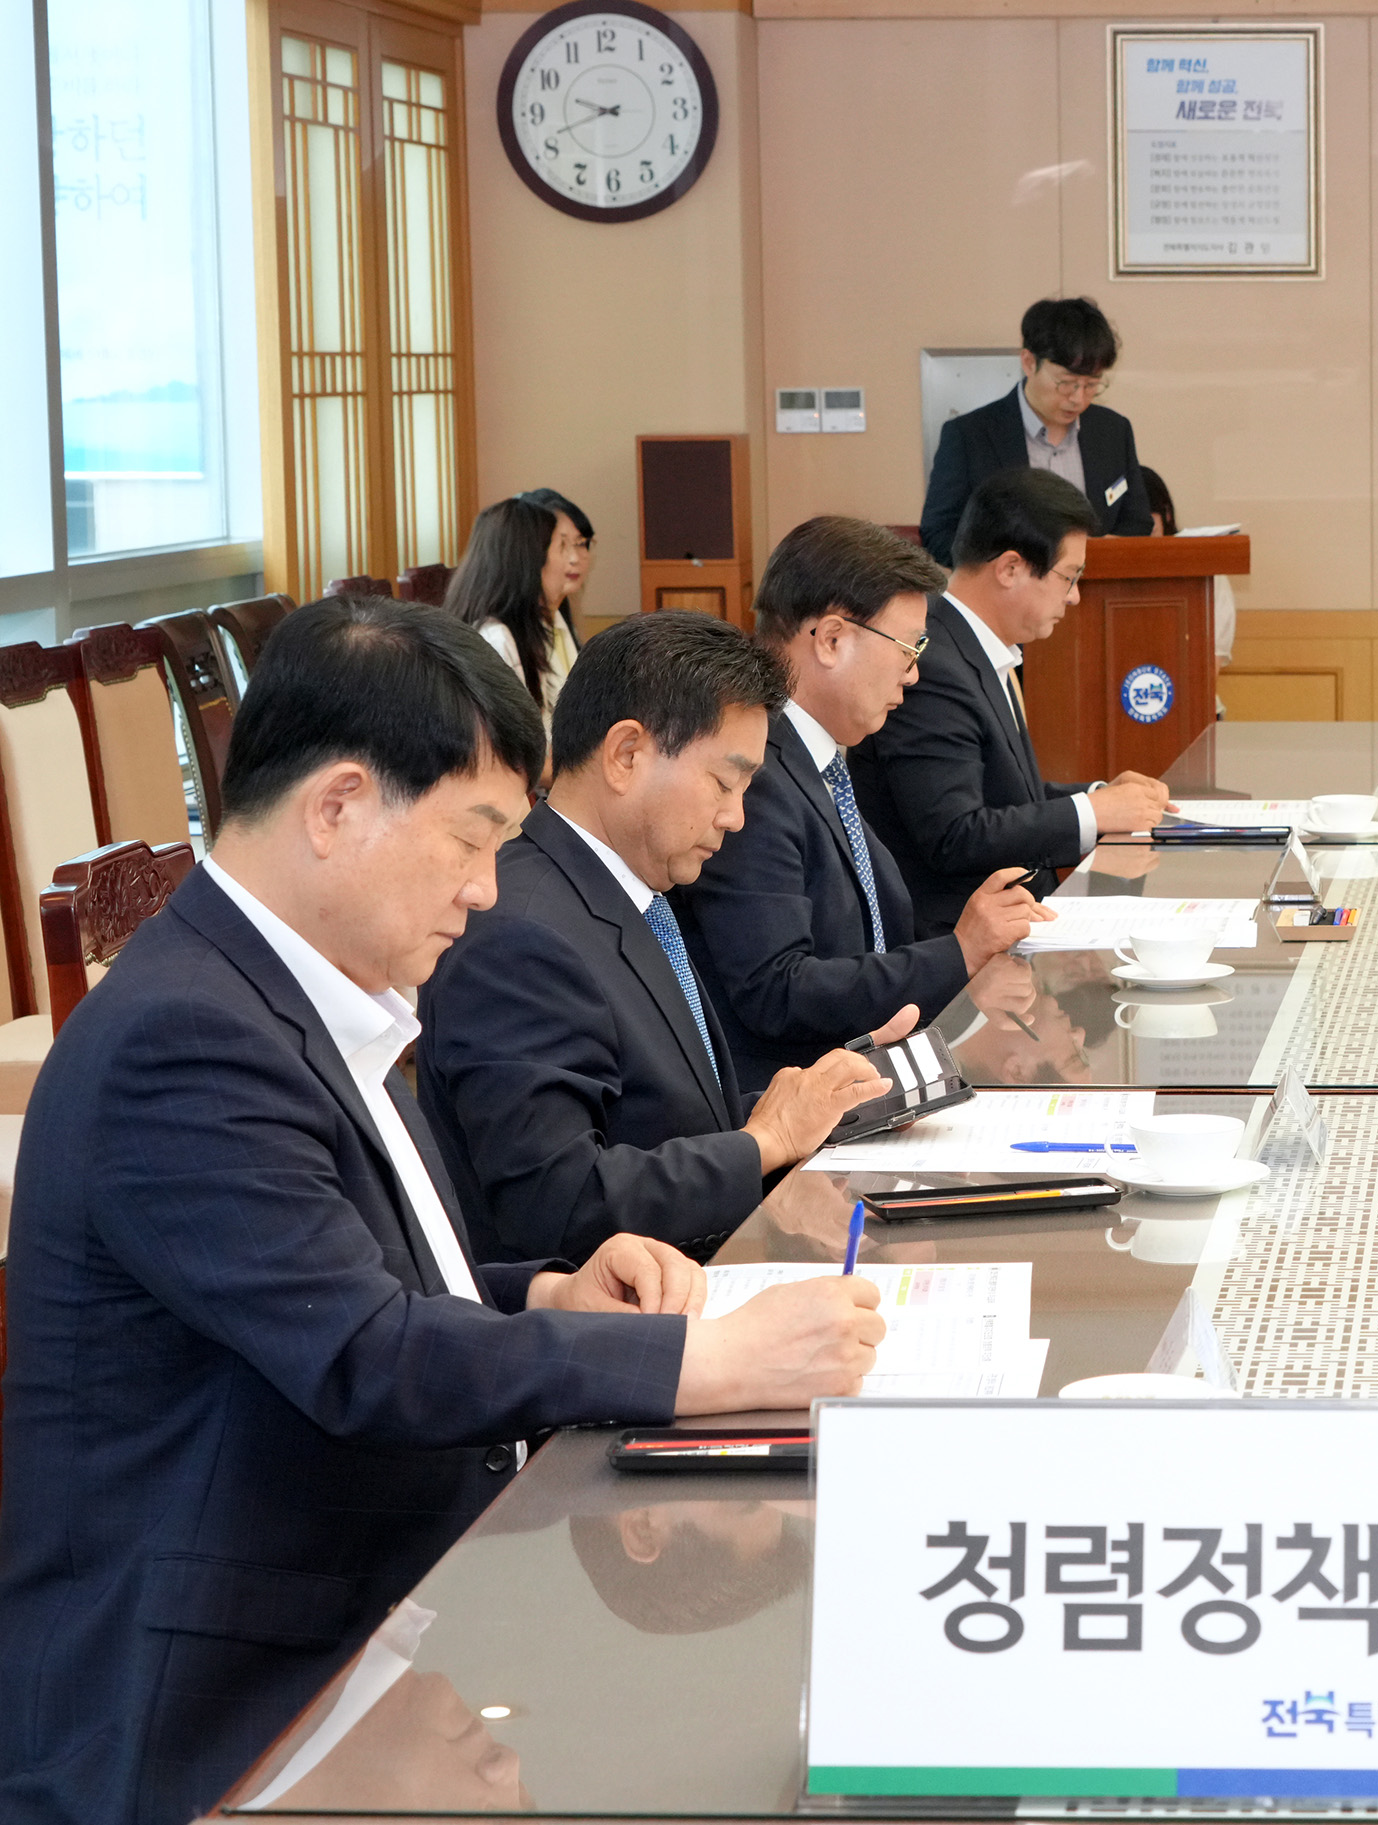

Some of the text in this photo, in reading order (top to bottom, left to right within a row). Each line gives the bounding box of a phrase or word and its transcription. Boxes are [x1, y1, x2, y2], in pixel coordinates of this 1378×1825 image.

[566, 41, 580, 64] 11
[597, 29, 616, 53] 12
[638, 39, 644, 61] 1
[660, 62, 674, 86] 2
[1146, 58, 1175, 73] 함께
[541, 68, 559, 91] 10
[1176, 79, 1205, 94] 함께
[530, 102, 545, 126] 9
[672, 97, 689, 121] 3
[1175, 100, 1238, 120] 새로운
[544, 137, 559, 161] 8
[662, 133, 679, 156] 4
[574, 163, 587, 186] 7
[606, 168, 621, 192] 6
[640, 160, 654, 184] 5
[1133, 683, 1165, 705] 전북
